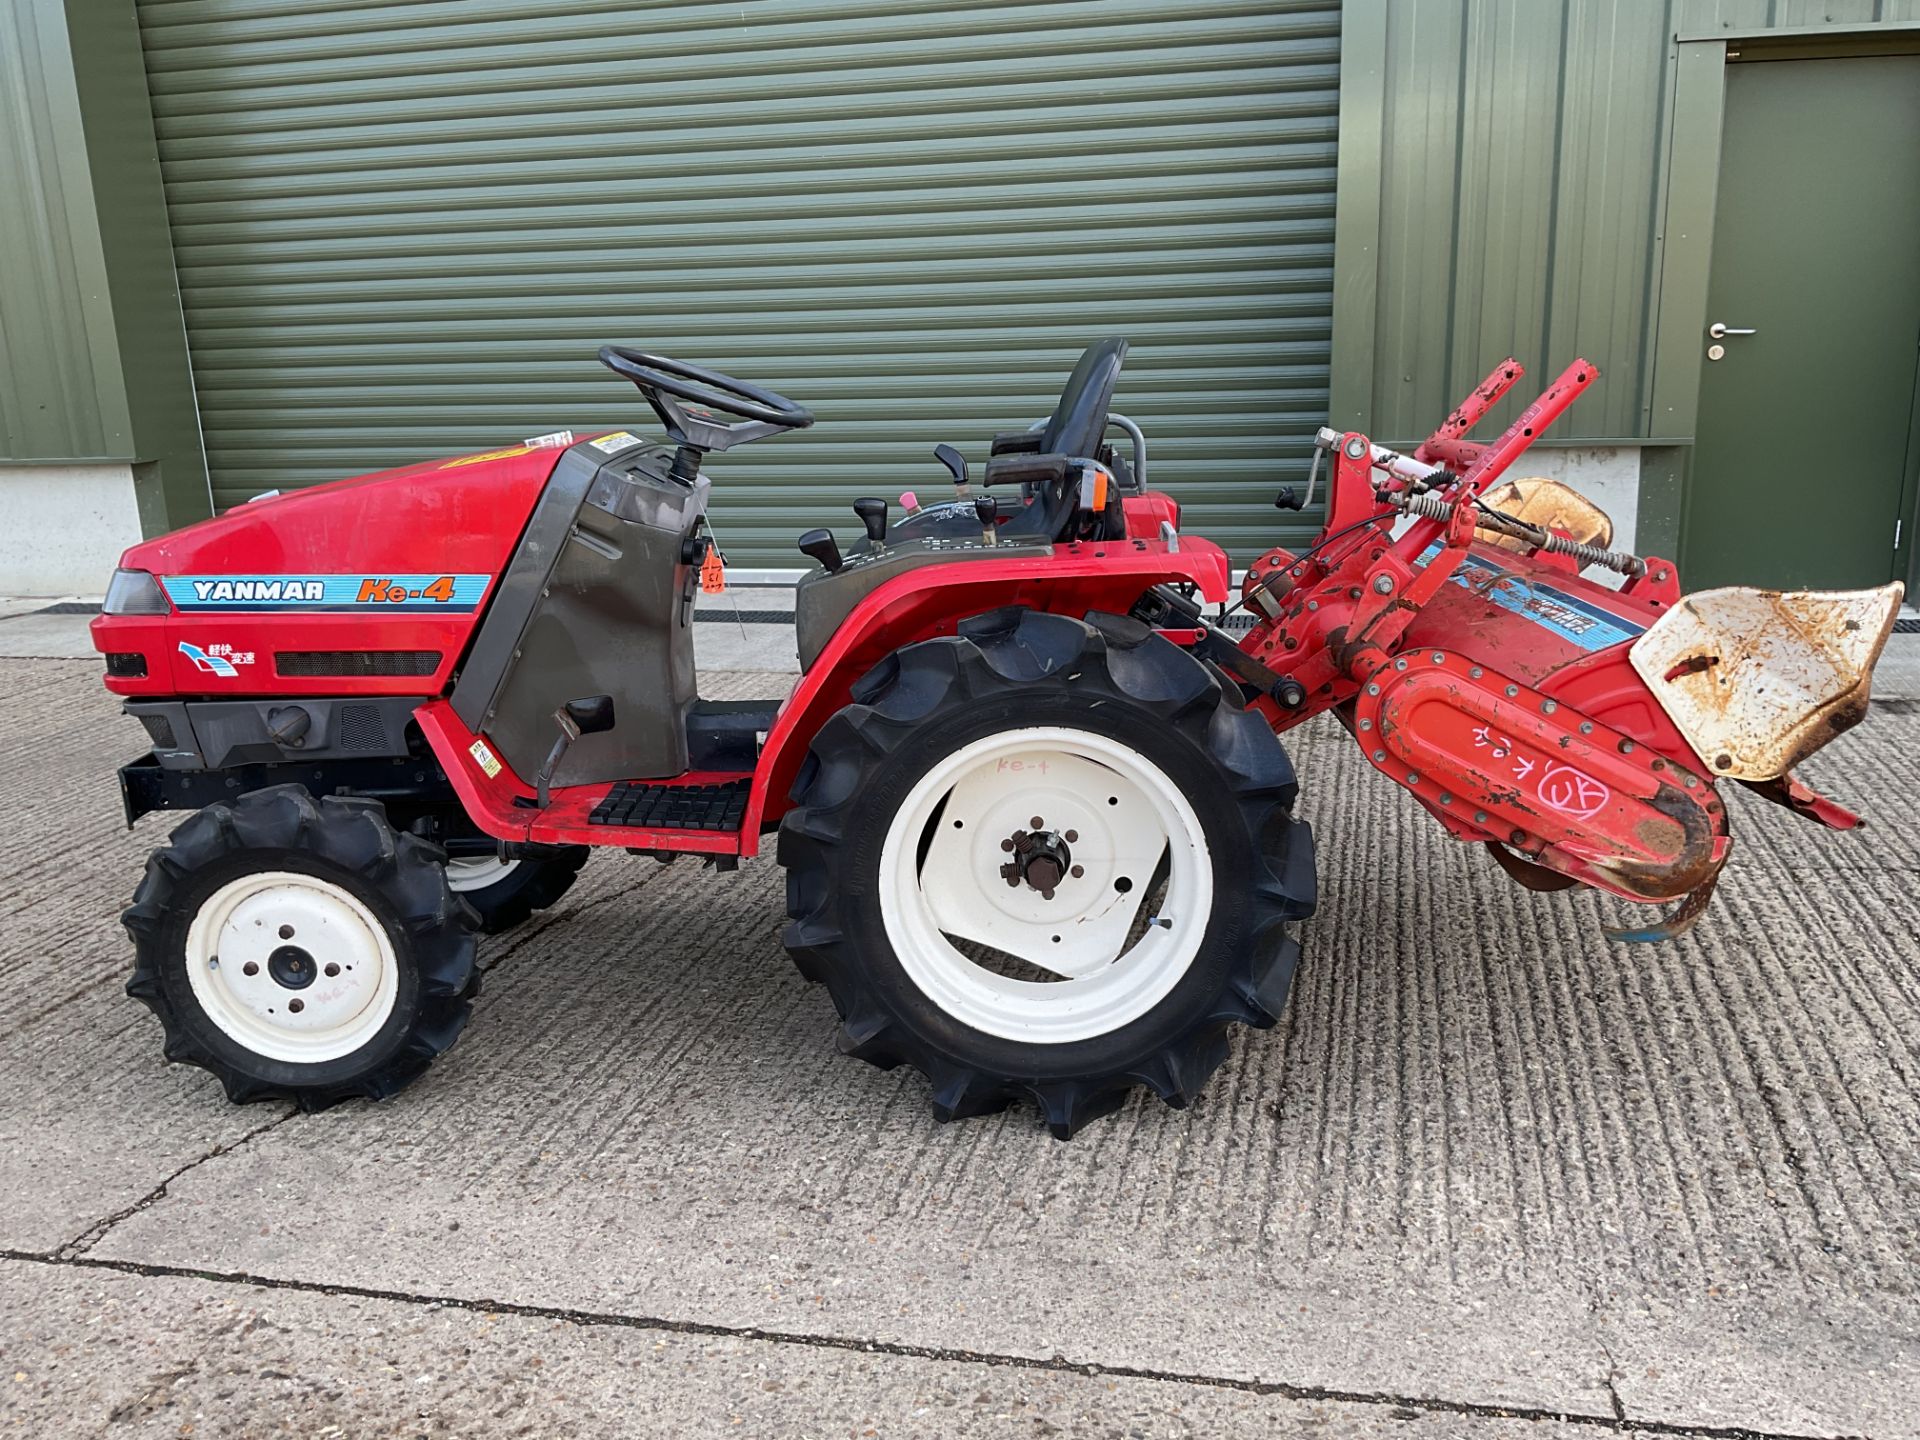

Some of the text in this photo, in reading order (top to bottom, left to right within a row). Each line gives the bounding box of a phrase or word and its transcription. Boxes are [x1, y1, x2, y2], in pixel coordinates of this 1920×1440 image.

[192, 575, 456, 603] YANMAR Ke-4
[1550, 776, 1606, 810] UK
